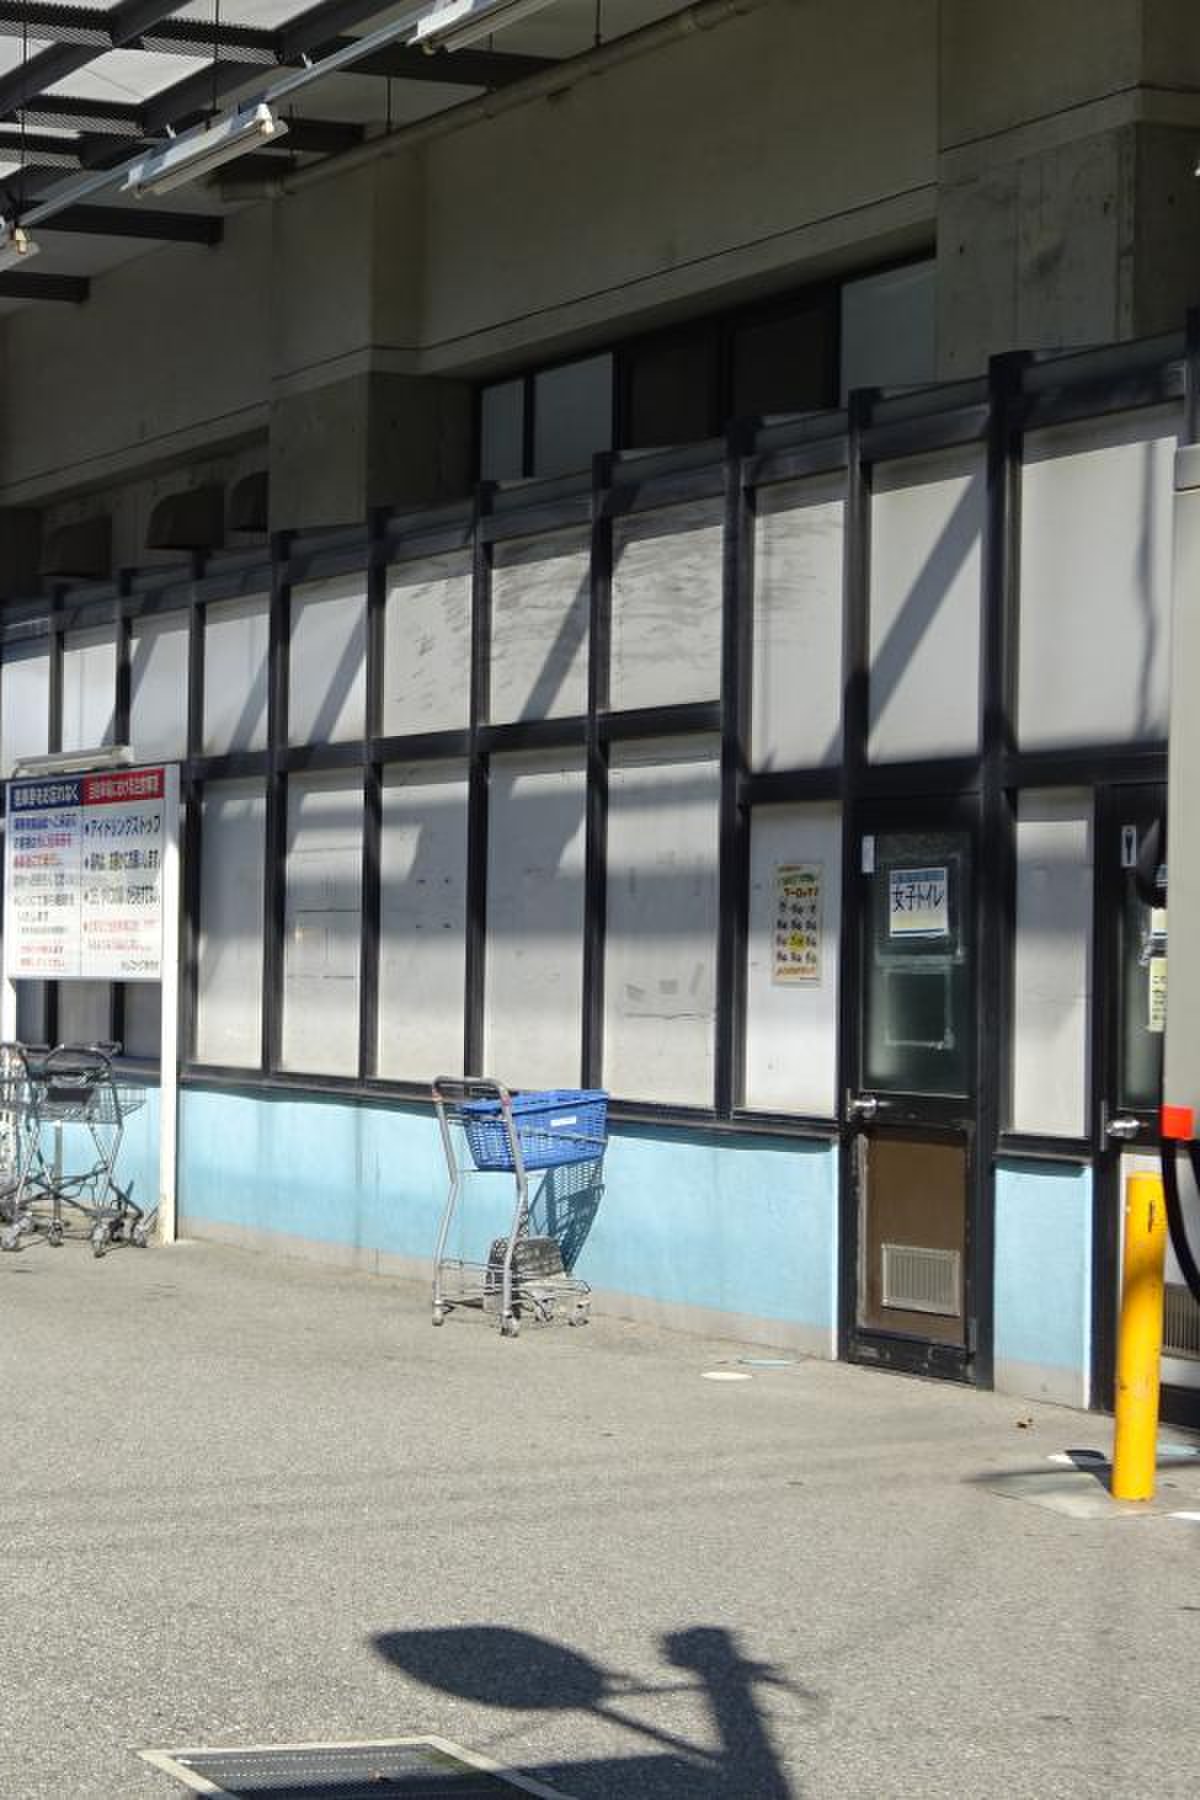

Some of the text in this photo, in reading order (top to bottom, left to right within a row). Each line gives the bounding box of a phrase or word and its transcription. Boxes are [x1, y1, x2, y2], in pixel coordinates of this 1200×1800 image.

[892, 882, 945, 913] 女子トイレ
